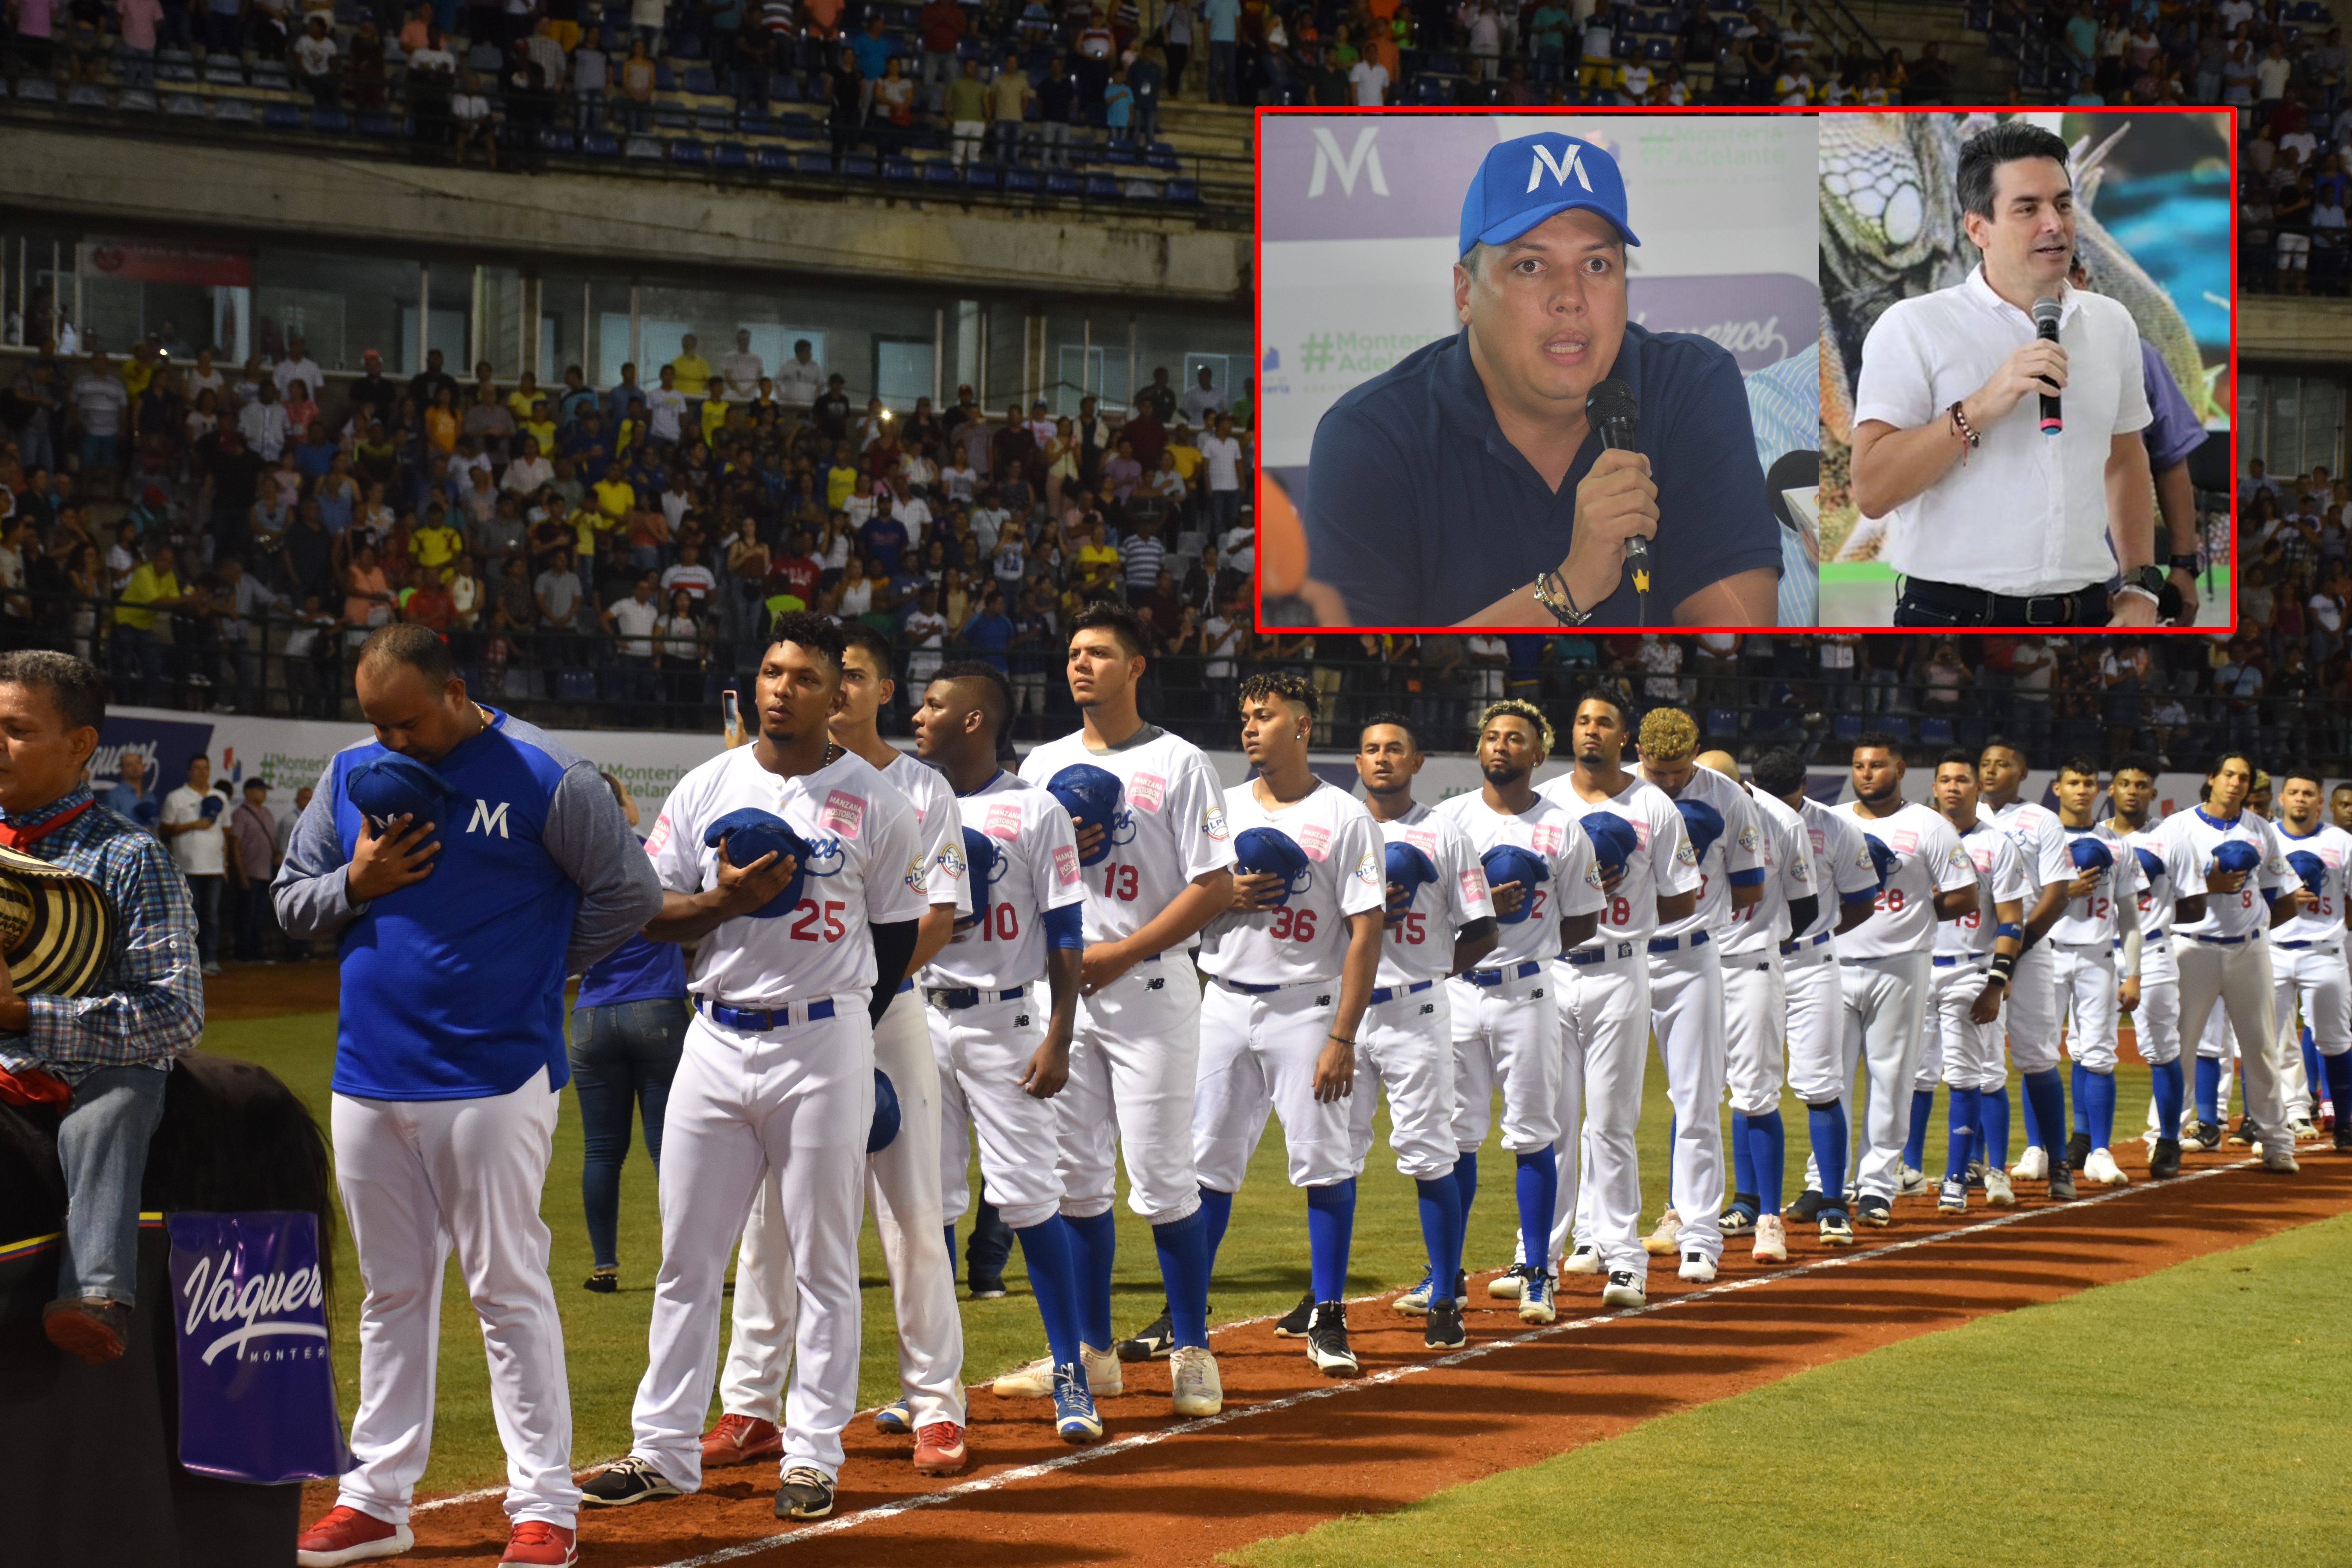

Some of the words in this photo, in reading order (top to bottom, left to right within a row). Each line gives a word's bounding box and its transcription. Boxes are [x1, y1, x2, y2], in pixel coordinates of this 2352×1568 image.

[1306, 125, 1390, 199] M
[1526, 144, 1594, 193] M
[1131, 787, 1160, 799] POSTOBON
[1134, 777, 1162, 791] MANZANA
[825, 808, 858, 823] POSTOBON
[829, 796, 862, 814] MANZANA
[990, 809, 1021, 820] MANZANA
[466, 799, 510, 839] M
[987, 817, 1019, 829] POSTOBON
[1303, 829, 1331, 842] MANZANA
[1407, 834, 1435, 842] MANZANA
[1105, 862, 1138, 901] 13
[1601, 896, 1630, 926] 18
[1874, 888, 1904, 912] 28
[2087, 896, 2109, 920] 12
[2307, 897, 2332, 915] 45
[790, 897, 846, 943] 25
[984, 902, 1019, 941] 10
[1269, 906, 1317, 942] 36
[1395, 912, 1426, 945] 15
[250, 1346, 325, 1363] MONTER
